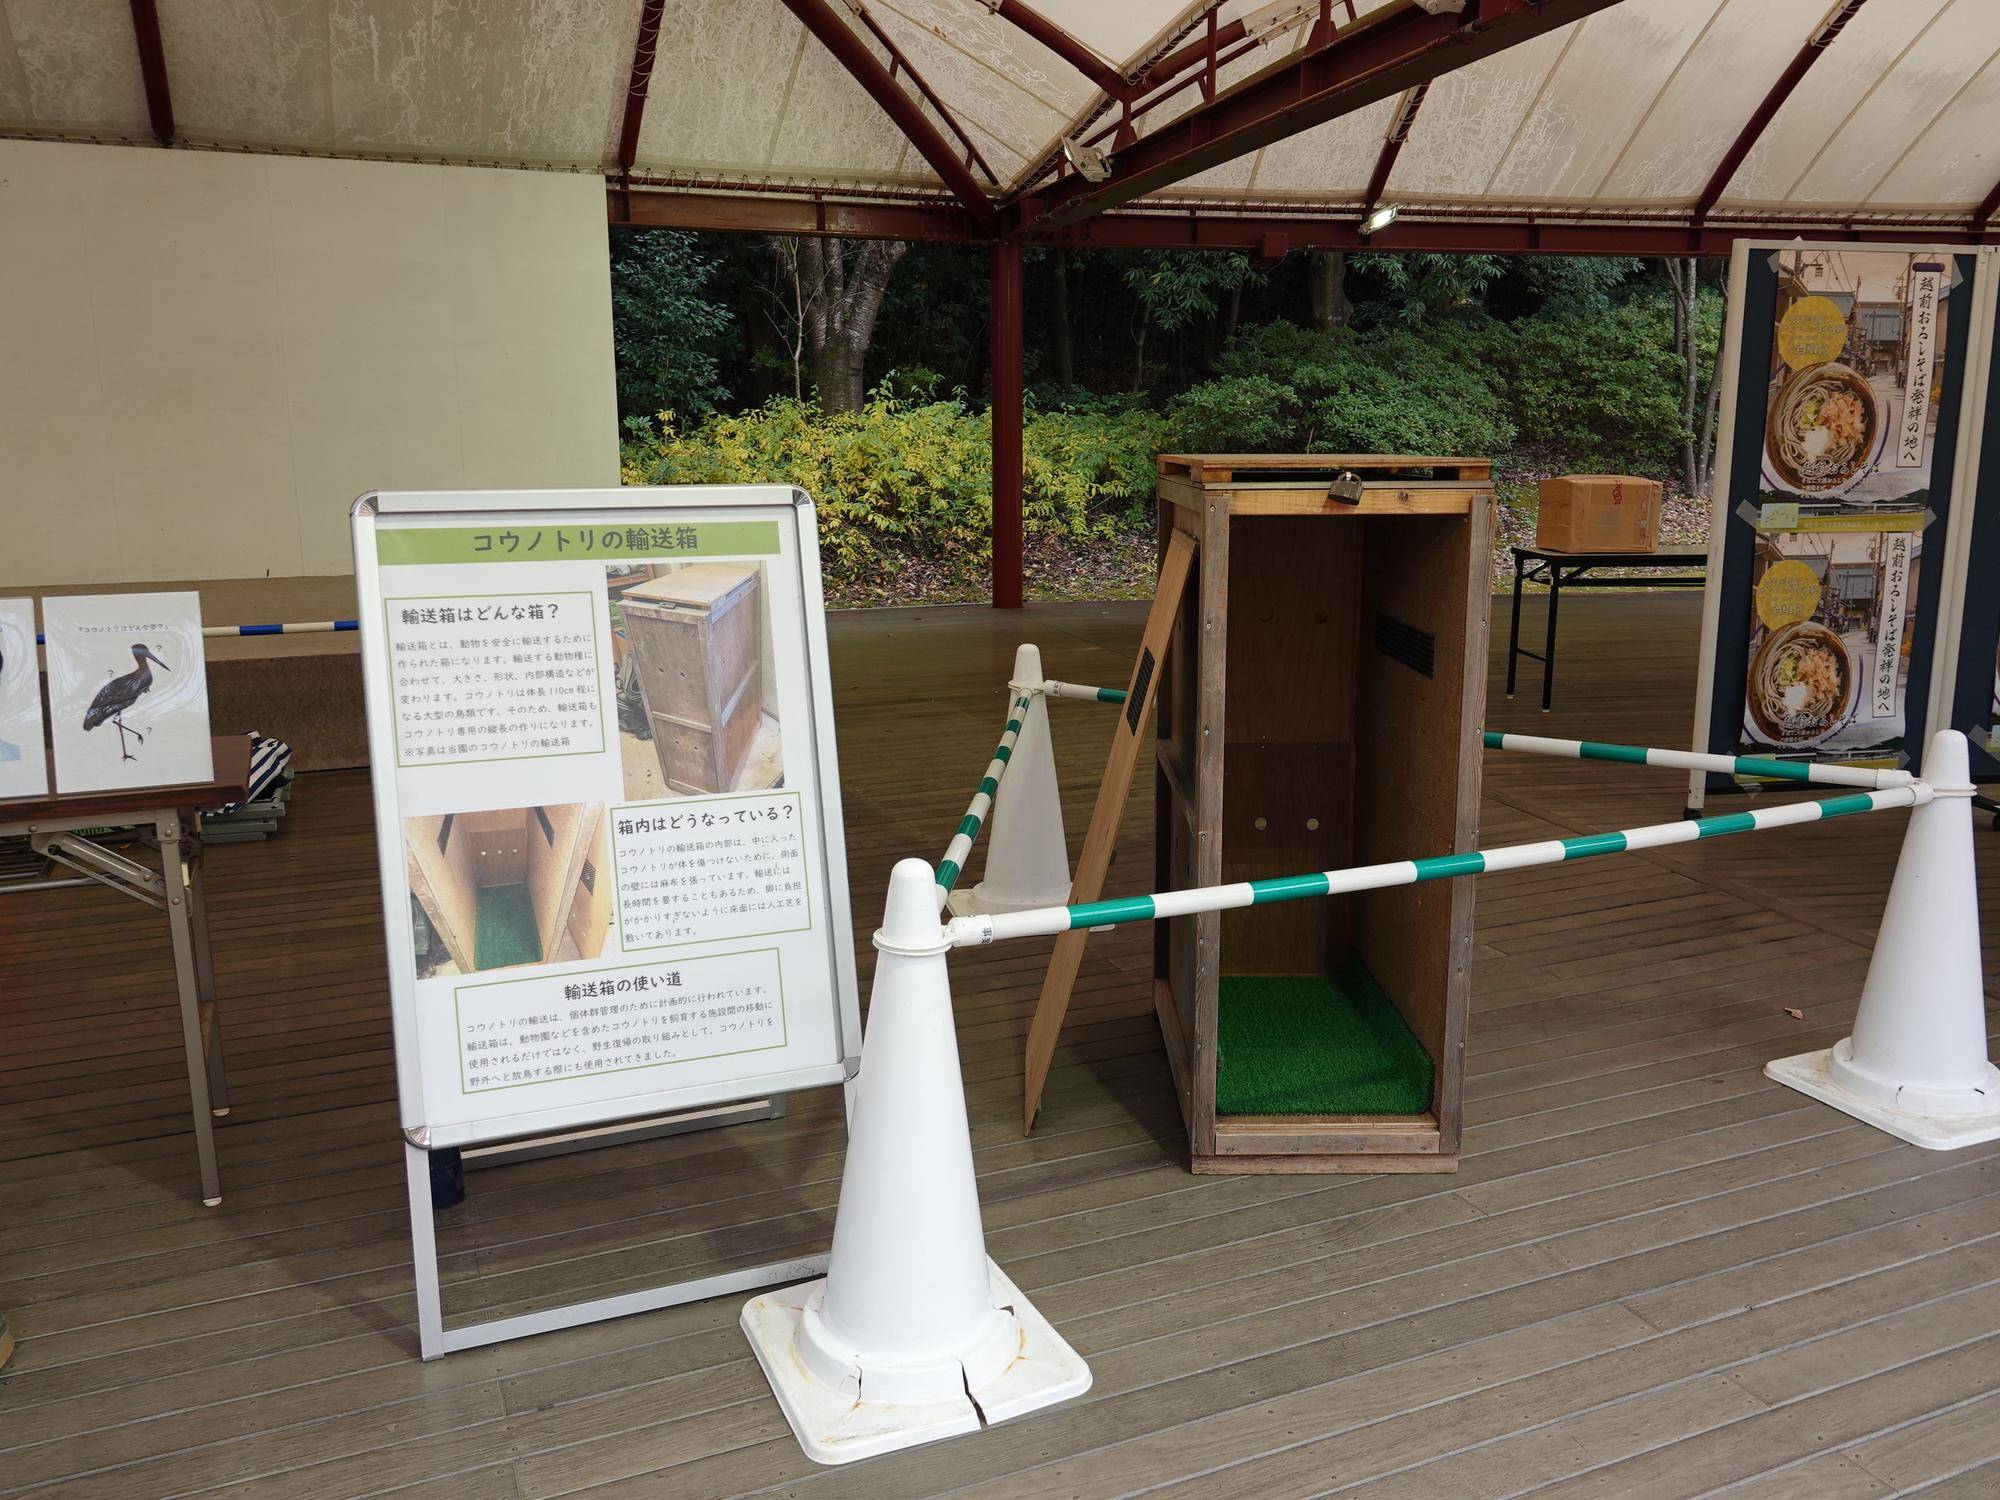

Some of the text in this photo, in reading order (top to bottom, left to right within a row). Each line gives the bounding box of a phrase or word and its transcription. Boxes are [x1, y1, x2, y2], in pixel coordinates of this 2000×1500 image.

[473, 527, 699, 554] コウノトリの輸送箱
[401, 603, 559, 625] 輸送箱はどんな箱？
[395, 634, 592, 652] 輸送箱とは、動物を安全に輸送するために
[397, 651, 593, 669] 作られた箱になります。輸送する動物種に
[399, 667, 595, 687] 合わせて、大きさ、形状、内部構造などが
[401, 702, 597, 722] なる大型の鳥類です。そのため、輸送箱も
[404, 718, 595, 739] コウノトリ専用の縦長の作りになります。
[618, 804, 794, 836] 箱内はどうなっている？
[619, 832, 797, 858] コウノトリの輸送箱の内部は、中に入った
[621, 866, 791, 892] の壁には麻布を張っています。輸送には
[624, 898, 802, 925] がかかりすぎないように床面には人工芝を
[625, 927, 697, 943] 敷いてあります。
[564, 970, 683, 1001] 輸送箱の使い道
[468, 1017, 774, 1069] 使用されるだけではなく、野生復帰の取り組みとして、コウノトリを
[469, 1050, 677, 1087] 野外へと放鳥する際にも使用されてきました。
